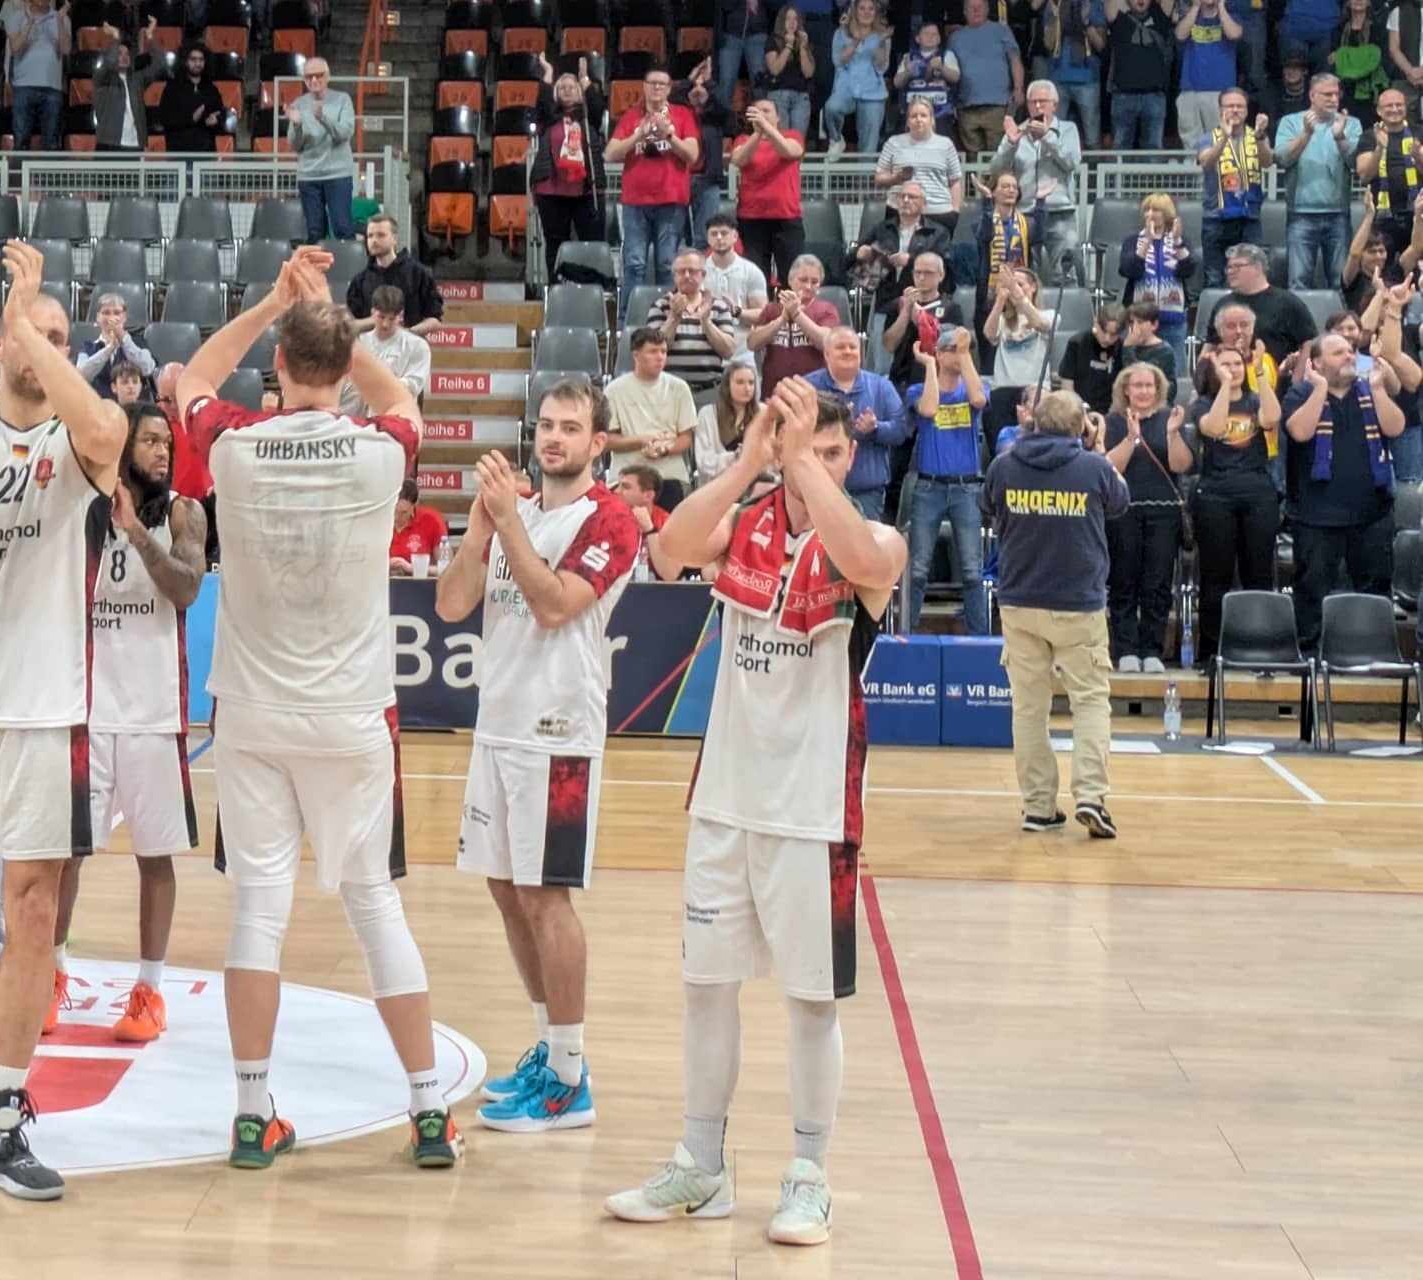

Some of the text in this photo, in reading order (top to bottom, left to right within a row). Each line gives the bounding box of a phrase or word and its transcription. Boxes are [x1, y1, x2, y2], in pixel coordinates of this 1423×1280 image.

[469, 286, 478, 298] 8
[459, 331, 468, 344] 7
[438, 377, 485, 390] Reihe 6
[458, 424, 467, 436] 5
[255, 437, 357, 461] URBANSKY
[417, 474, 455, 487] eihe 4
[1005, 488, 1089, 511] PHOENIX
[110, 549, 127, 583] 8
[93, 597, 155, 616] rthomol
[92, 617, 122, 630] port
[735, 652, 771, 674] port
[862, 682, 936, 697] VR Bank eG
[966, 684, 1013, 698] VR Ban
